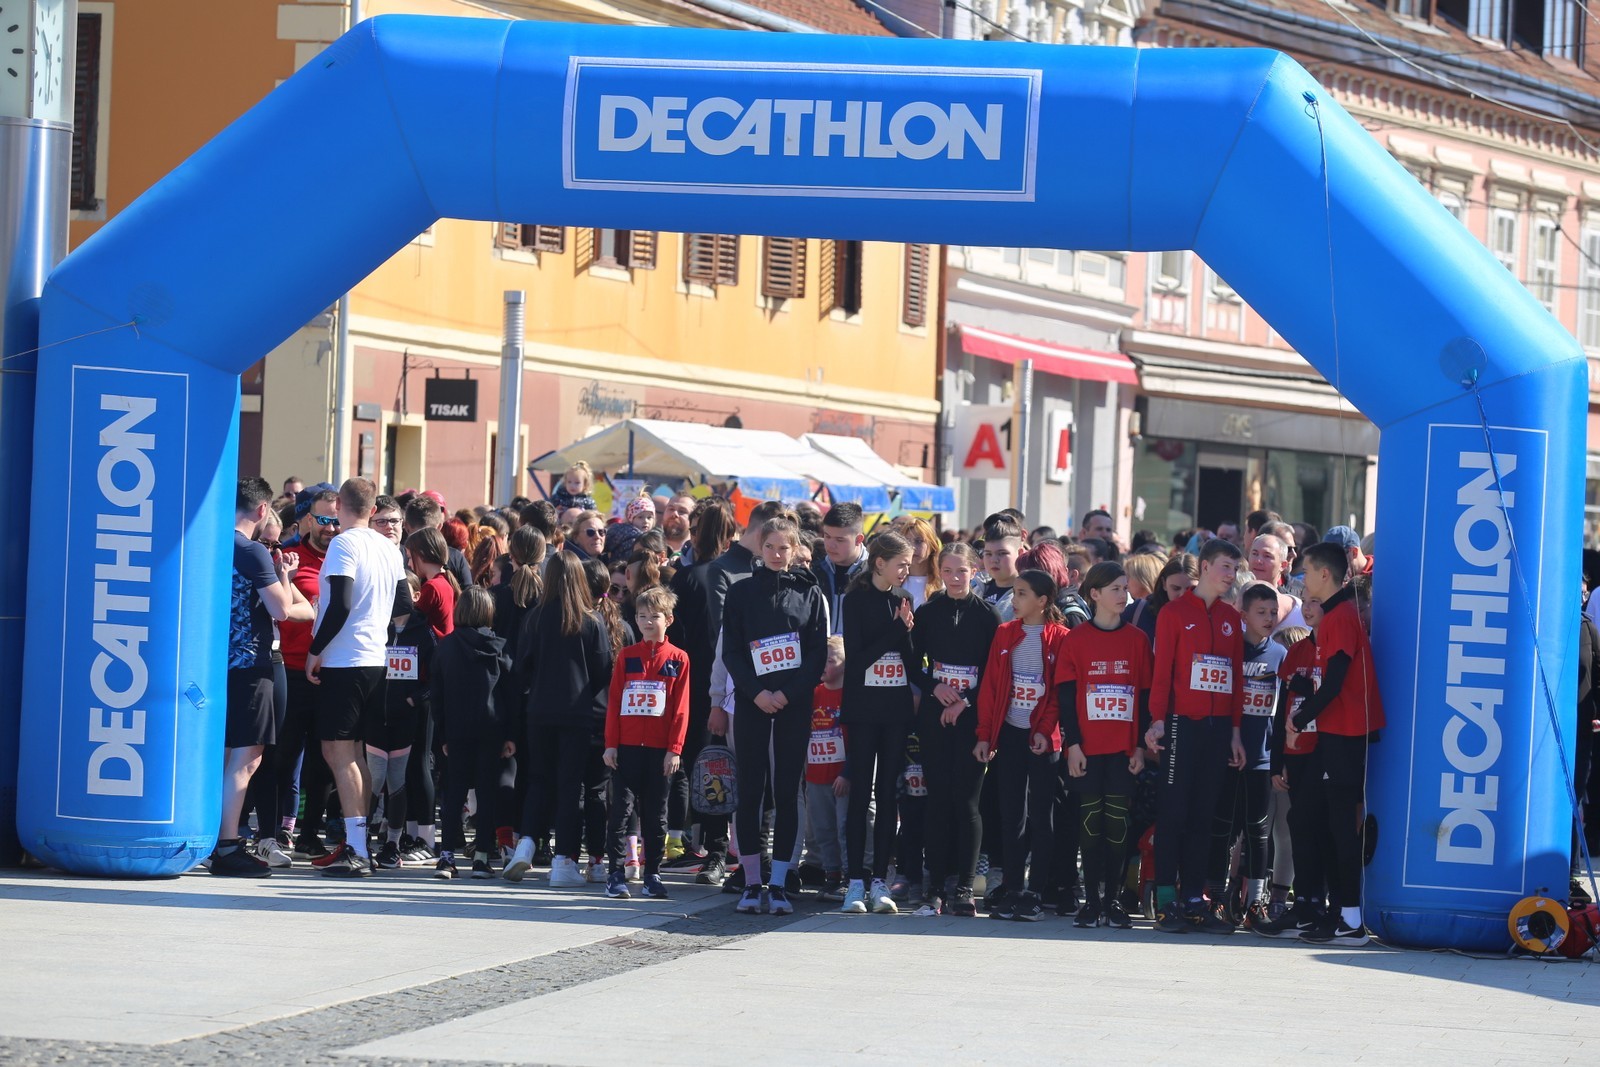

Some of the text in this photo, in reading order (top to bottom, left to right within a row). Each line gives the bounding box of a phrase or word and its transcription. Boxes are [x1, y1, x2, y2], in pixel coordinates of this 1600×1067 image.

[598, 94, 1003, 161] DECATHLON
[430, 404, 469, 417] TISAK
[87, 394, 157, 797] DECATHLON
[760, 646, 796, 665] 608
[1436, 451, 1517, 866] DECATHLON
[389, 657, 412, 671] 40
[873, 663, 904, 679] 499
[1242, 661, 1268, 677] NIKE
[1199, 667, 1228, 685] 192
[627, 693, 657, 708] 173
[1094, 697, 1128, 712] 475
[810, 741, 837, 756] 015
